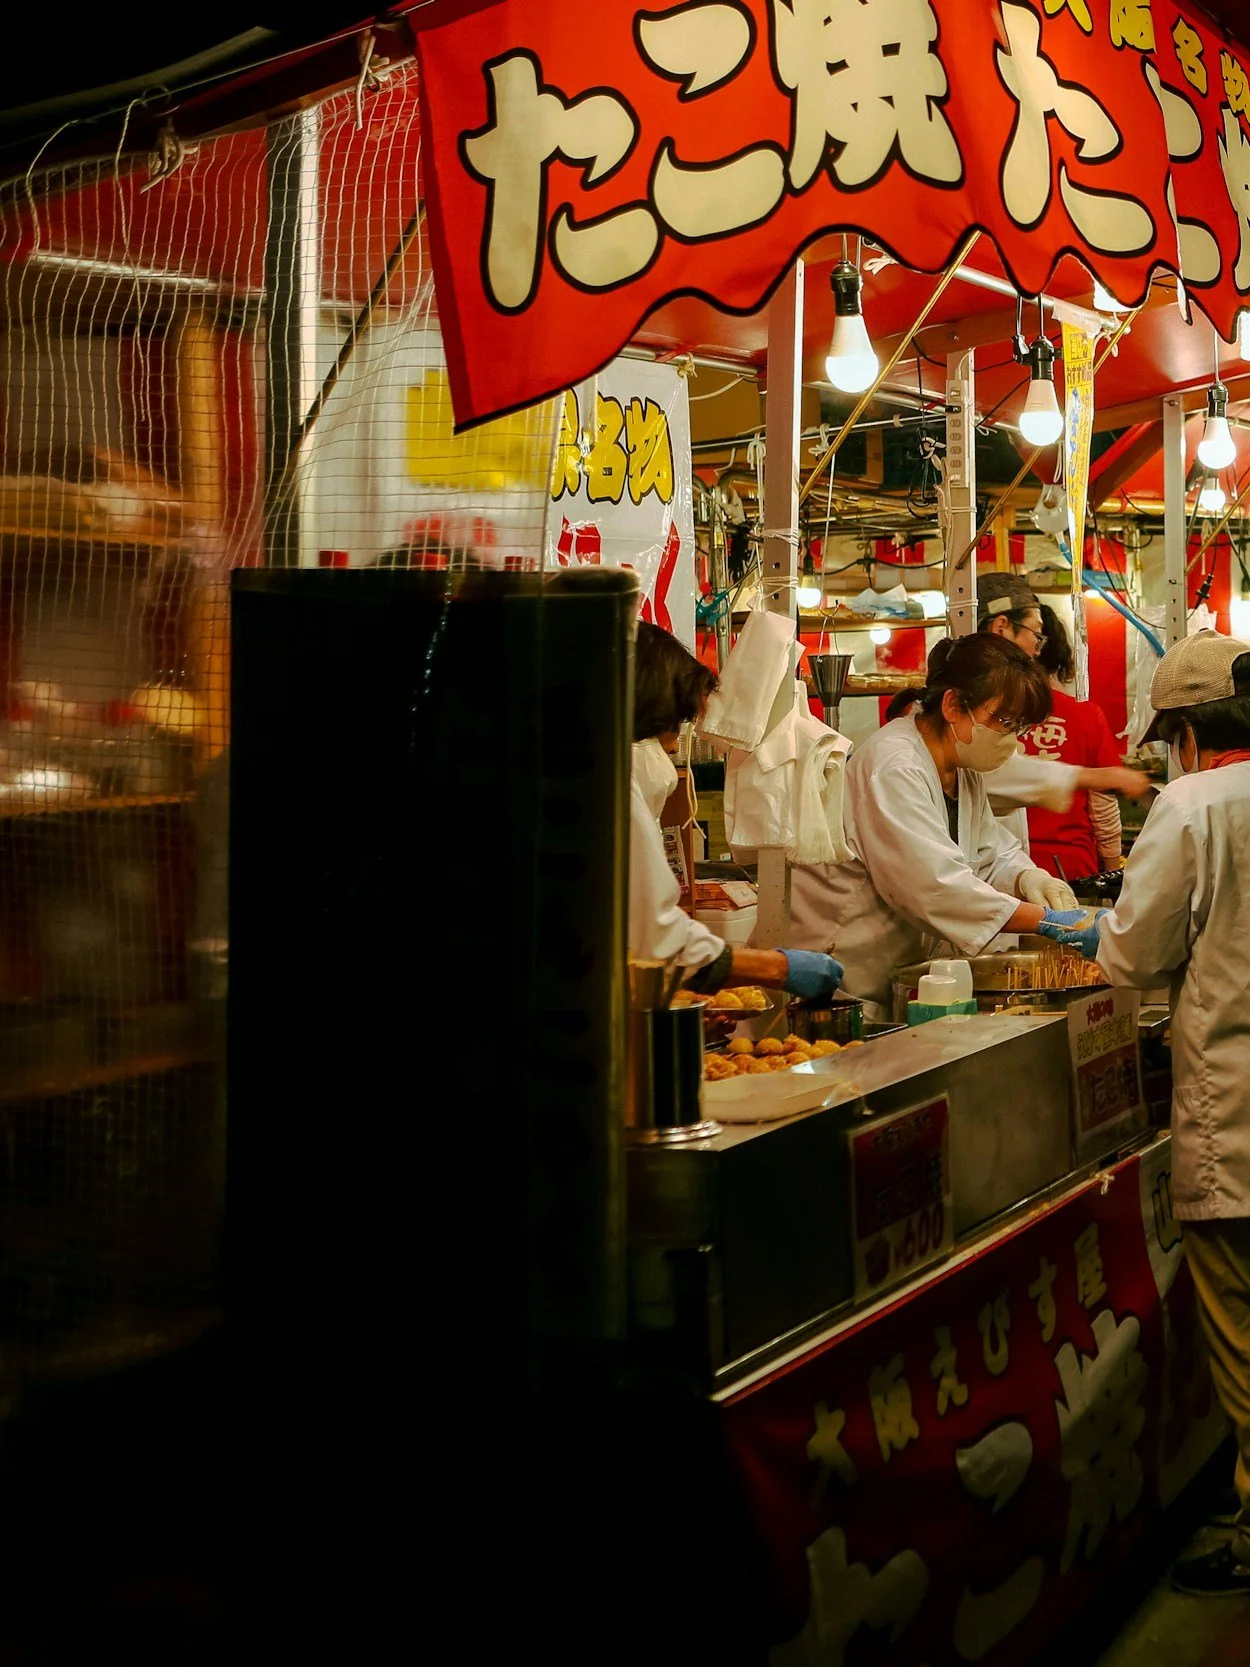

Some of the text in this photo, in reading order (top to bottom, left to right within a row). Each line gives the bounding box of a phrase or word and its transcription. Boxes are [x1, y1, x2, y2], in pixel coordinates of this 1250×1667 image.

[459, 0, 965, 315] たこ焼
[805, 1222, 1108, 1510] 大阪えびす屋
